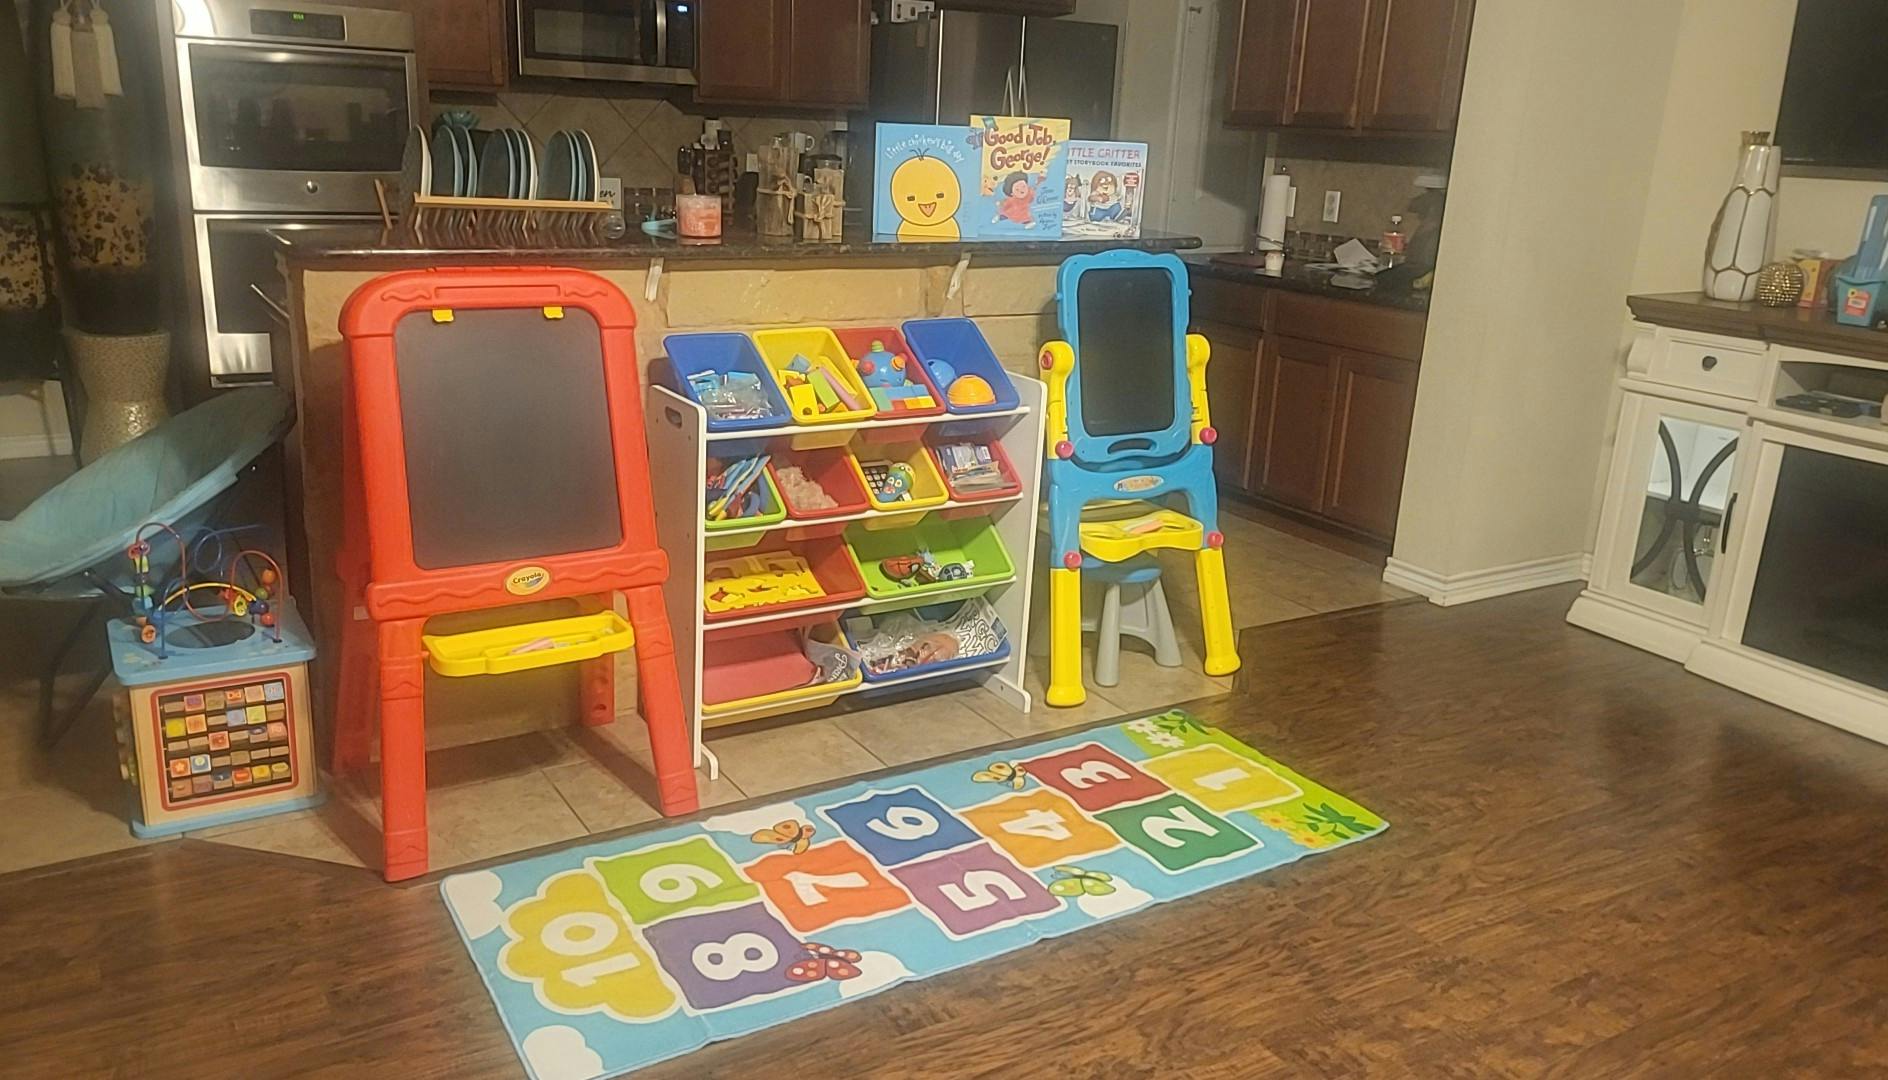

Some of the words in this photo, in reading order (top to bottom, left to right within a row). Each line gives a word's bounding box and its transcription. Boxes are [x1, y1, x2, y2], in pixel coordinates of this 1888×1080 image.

[985, 124, 1023, 146] Good
[991, 147, 1051, 170] George!
[1070, 147, 1094, 158] TTLE
[1097, 148, 1140, 159] CRITTER
[600, 190, 616, 198] en
[512, 572, 541, 584] Crayola
[1060, 760, 1130, 790] 3
[1195, 768, 1248, 791] 1
[864, 806, 939, 840] 6
[1001, 809, 1071, 840] 4
[1145, 805, 1221, 848] 2
[640, 864, 722, 902] 9
[785, 871, 868, 905] 7
[938, 868, 1020, 912] 5
[541, 912, 640, 988] 10
[692, 932, 779, 981] 8
